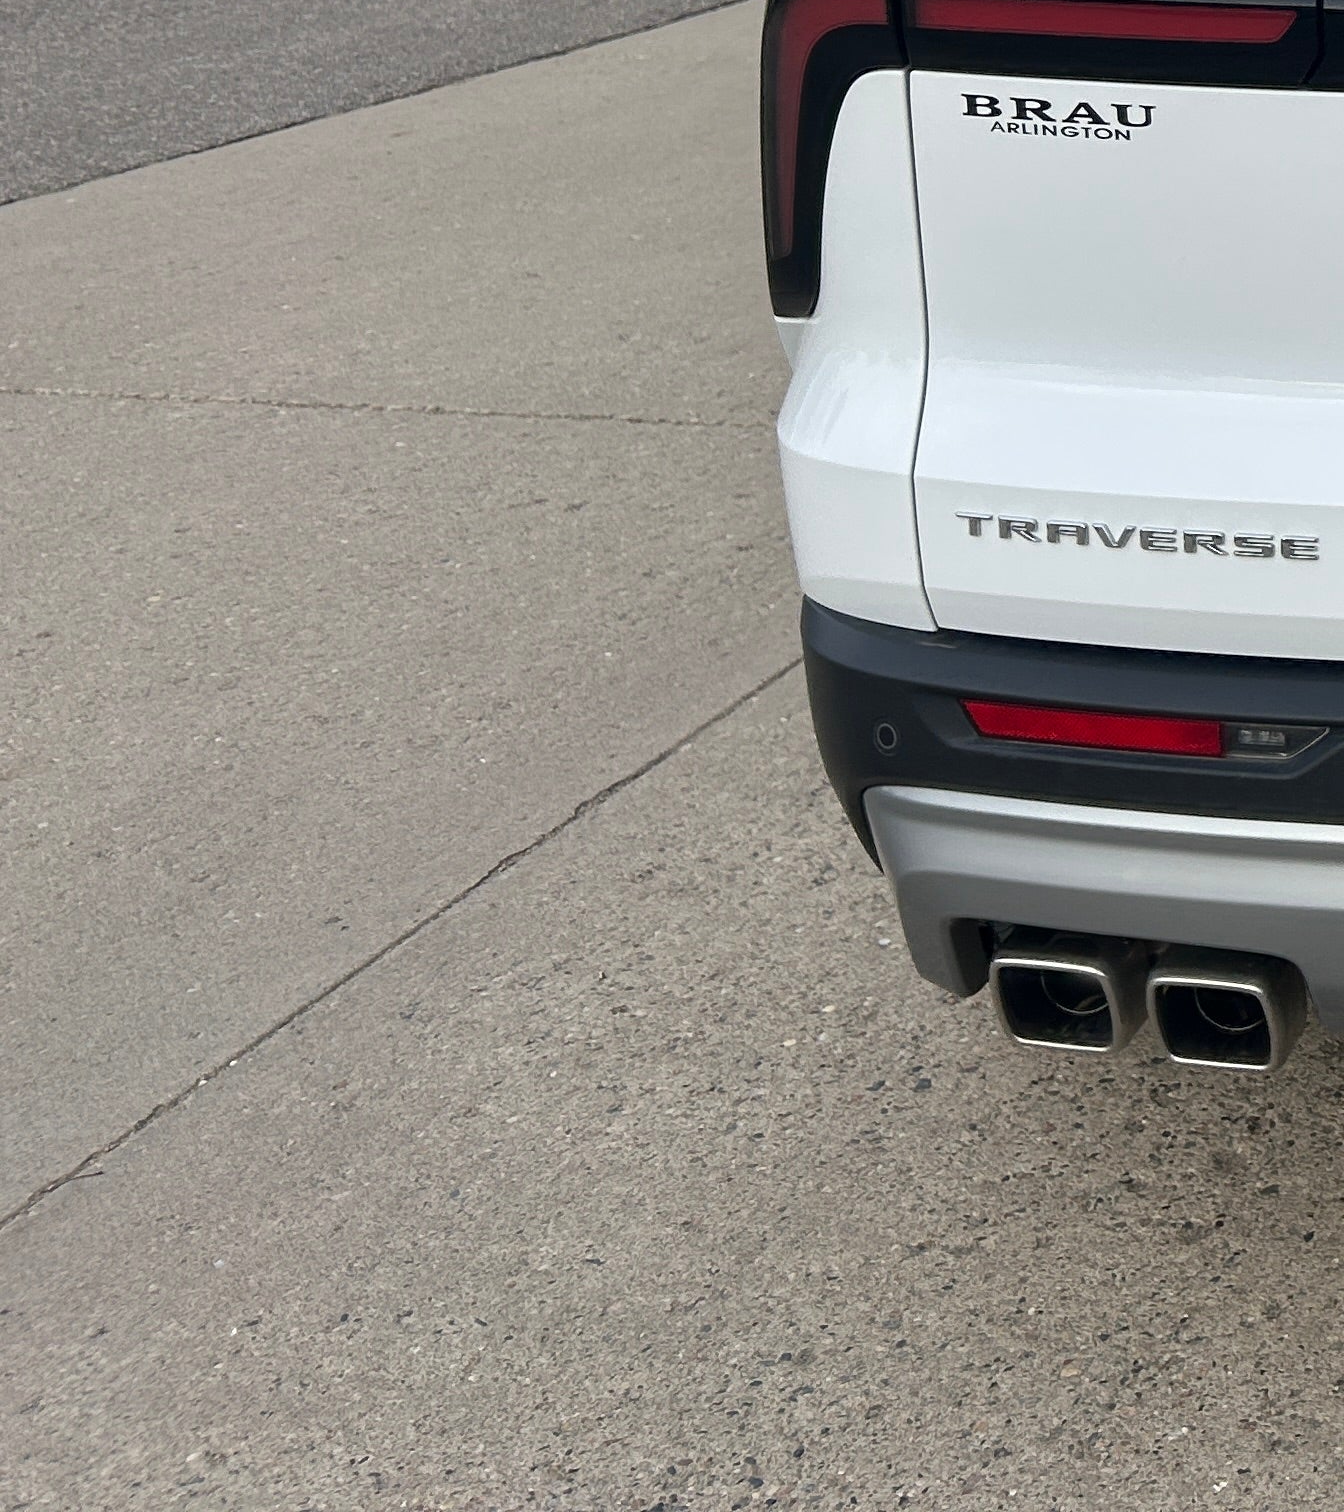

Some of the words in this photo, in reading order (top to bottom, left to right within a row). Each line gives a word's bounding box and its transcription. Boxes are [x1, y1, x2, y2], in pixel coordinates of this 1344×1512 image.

[960, 93, 1157, 128] BRAU
[990, 120, 1132, 141] ARLINGTON
[955, 511, 1320, 561] TRAVERSE
